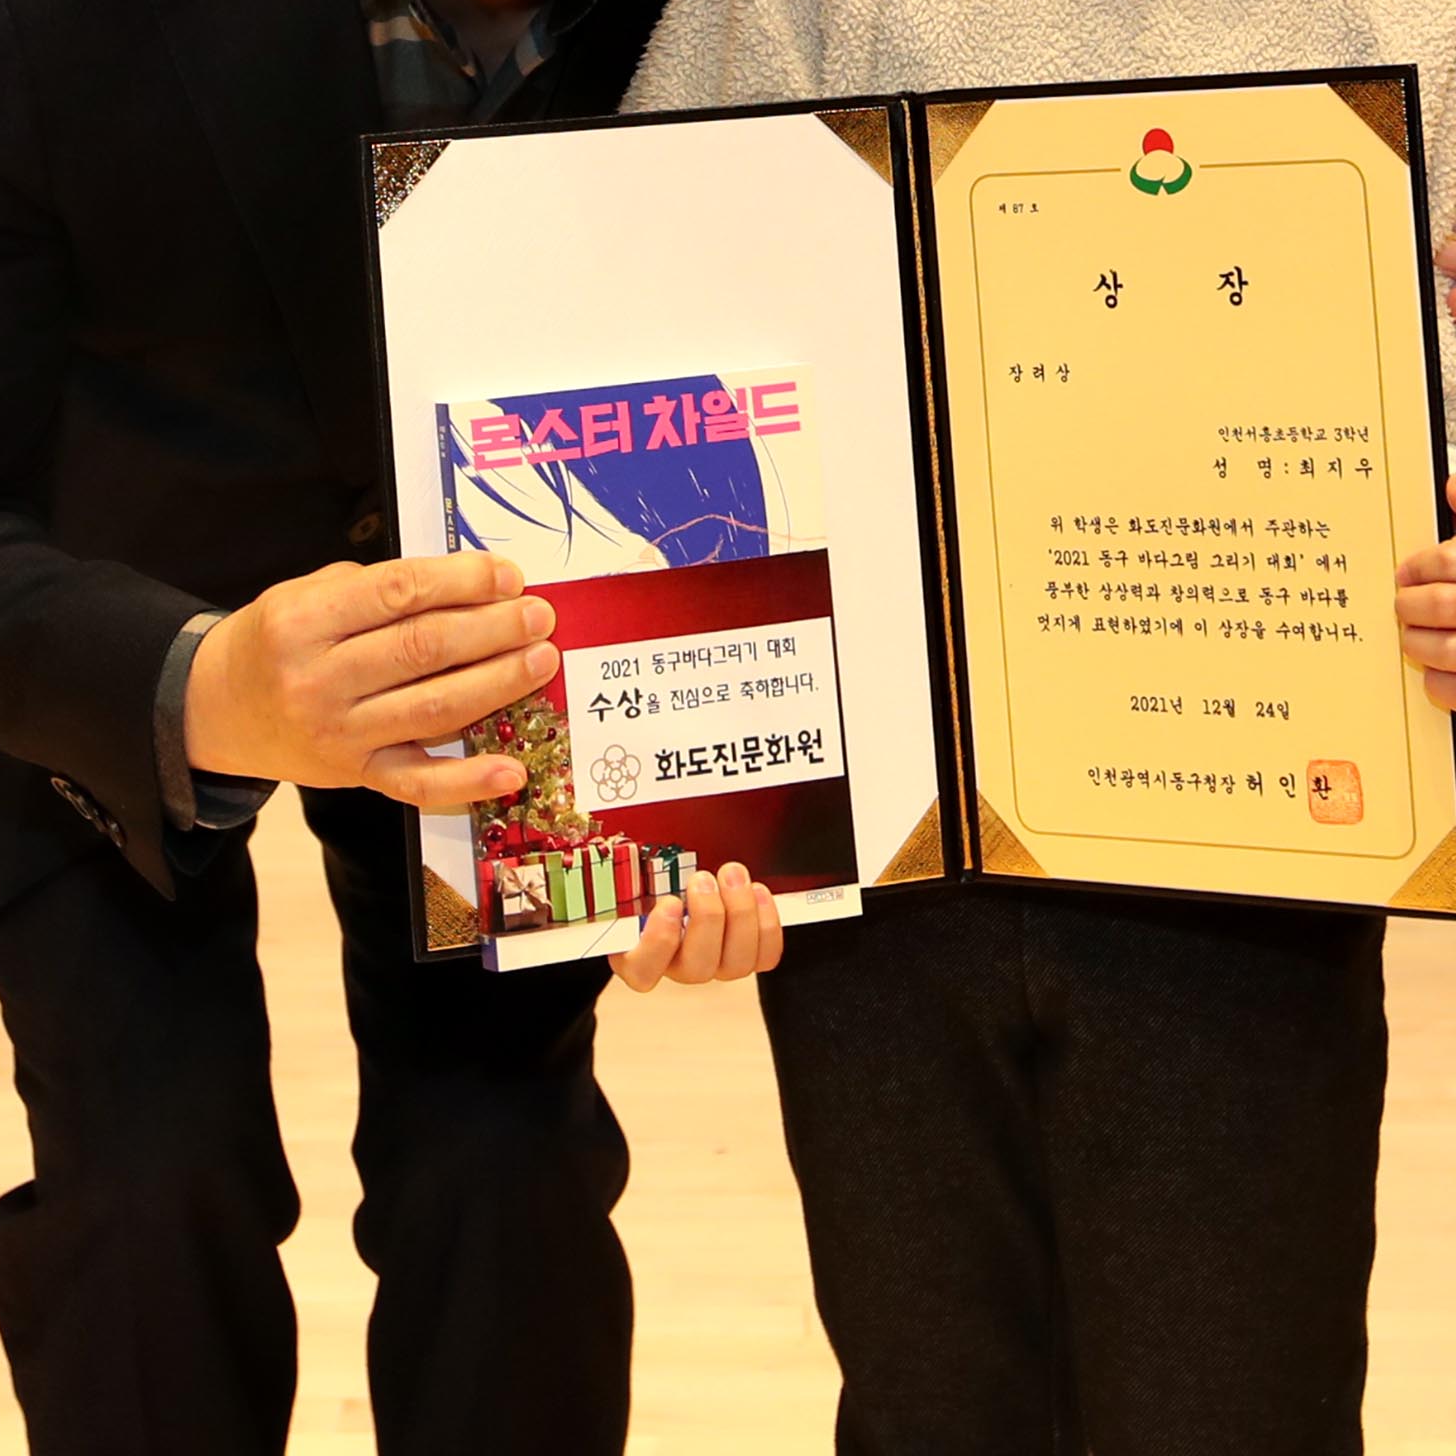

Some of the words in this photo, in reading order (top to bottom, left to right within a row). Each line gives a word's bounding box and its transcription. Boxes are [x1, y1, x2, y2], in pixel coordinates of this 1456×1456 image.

[470, 401, 633, 471] 몬스터
[644, 382, 801, 451] 차일드
[1333, 425, 1369, 443] 3학년
[1050, 515, 1064, 534] 위
[1073, 515, 1120, 536] 학생은
[1128, 516, 1254, 537] 화도진문화원에서
[1264, 518, 1331, 539] 주관하는
[1098, 549, 1129, 569] 동구
[1137, 549, 1199, 570] 바다그림
[1209, 551, 1256, 571] 그리기
[1315, 553, 1347, 574] 에서
[1044, 580, 1091, 601] 풍부한
[1098, 581, 1161, 603] 상상력과
[1170, 583, 1250, 604] 창의력으로
[1258, 586, 1291, 607] 동구
[1299, 587, 1349, 609] 바다를
[1037, 613, 1081, 633] 멋지게
[1091, 615, 1184, 637] 표현하였기에
[1193, 618, 1208, 638] 이
[1218, 618, 1267, 641] 상장을
[1275, 621, 1364, 643] 수여합니다.
[601, 658, 639, 680] 2021
[651, 641, 758, 675] 동구바다그리기
[767, 637, 796, 658] 대회
[587, 688, 660, 722] 수상을
[670, 684, 731, 711] 진심으로
[741, 673, 818, 700] 축하합니다.
[1130, 695, 1183, 716] 2021년
[1202, 698, 1236, 719] 12월
[1255, 700, 1290, 721] 24일
[654, 729, 825, 781] 화도진문화원
[1087, 766, 1236, 795] 인천광역시동구청장
